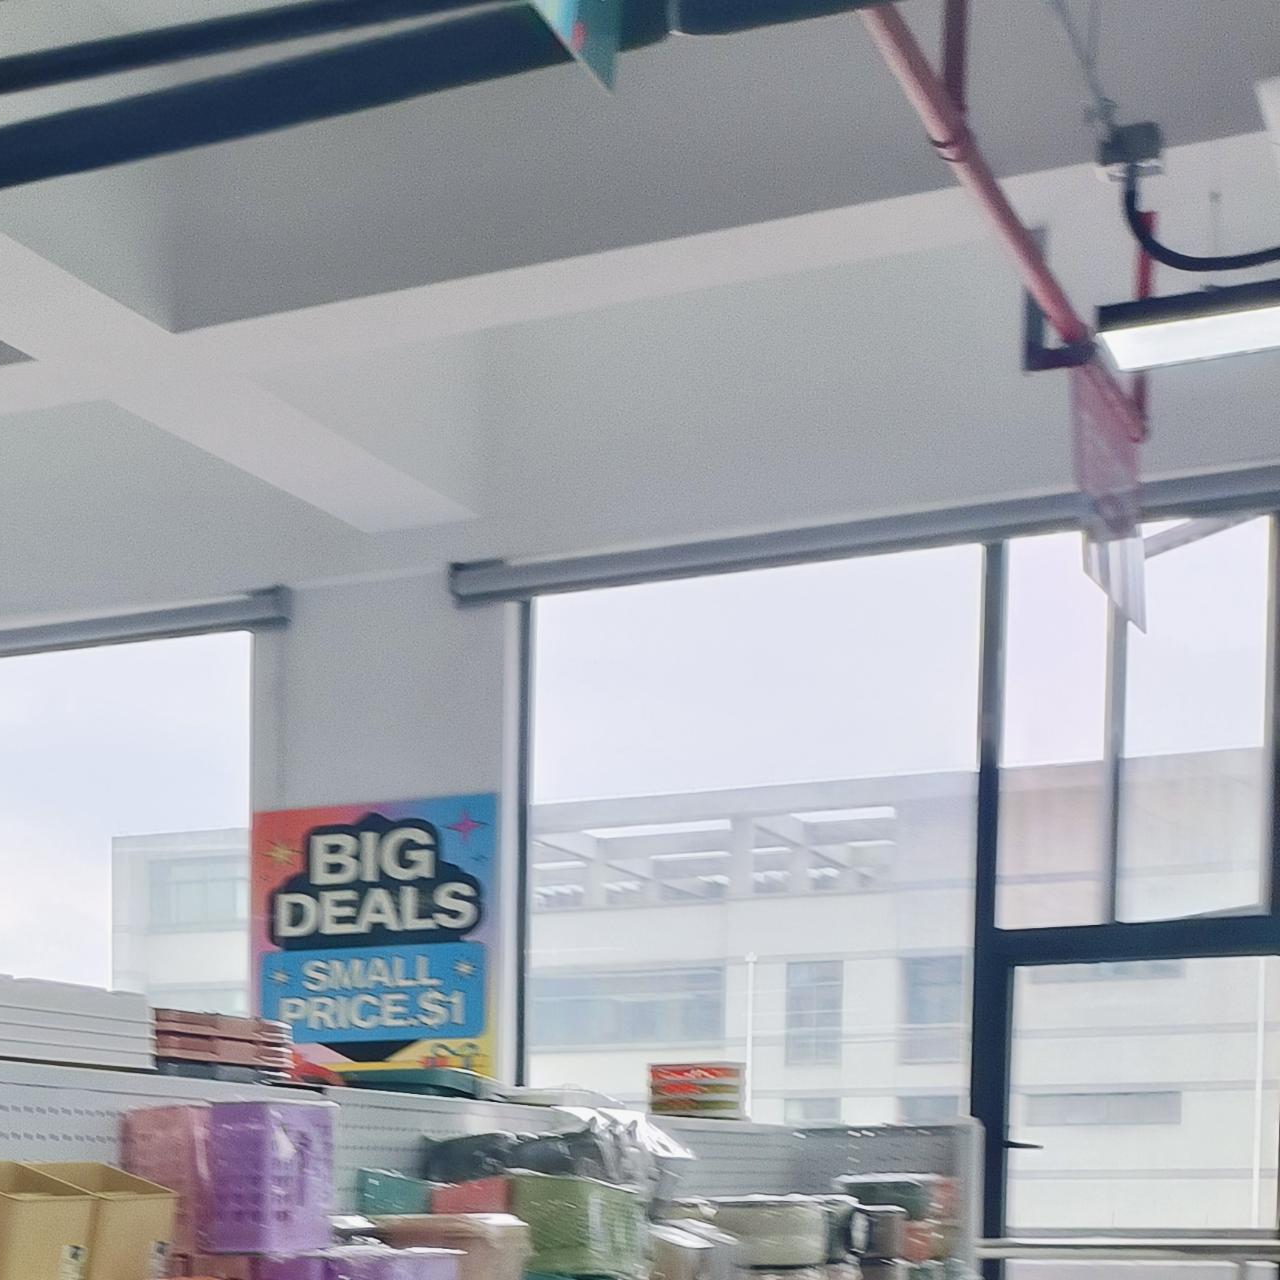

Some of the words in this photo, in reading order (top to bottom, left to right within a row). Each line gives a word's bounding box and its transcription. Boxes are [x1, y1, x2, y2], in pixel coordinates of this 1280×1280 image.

[309, 826, 436, 886] BIG
[274, 881, 480, 937] DEALS
[302, 954, 442, 992] SMALL
